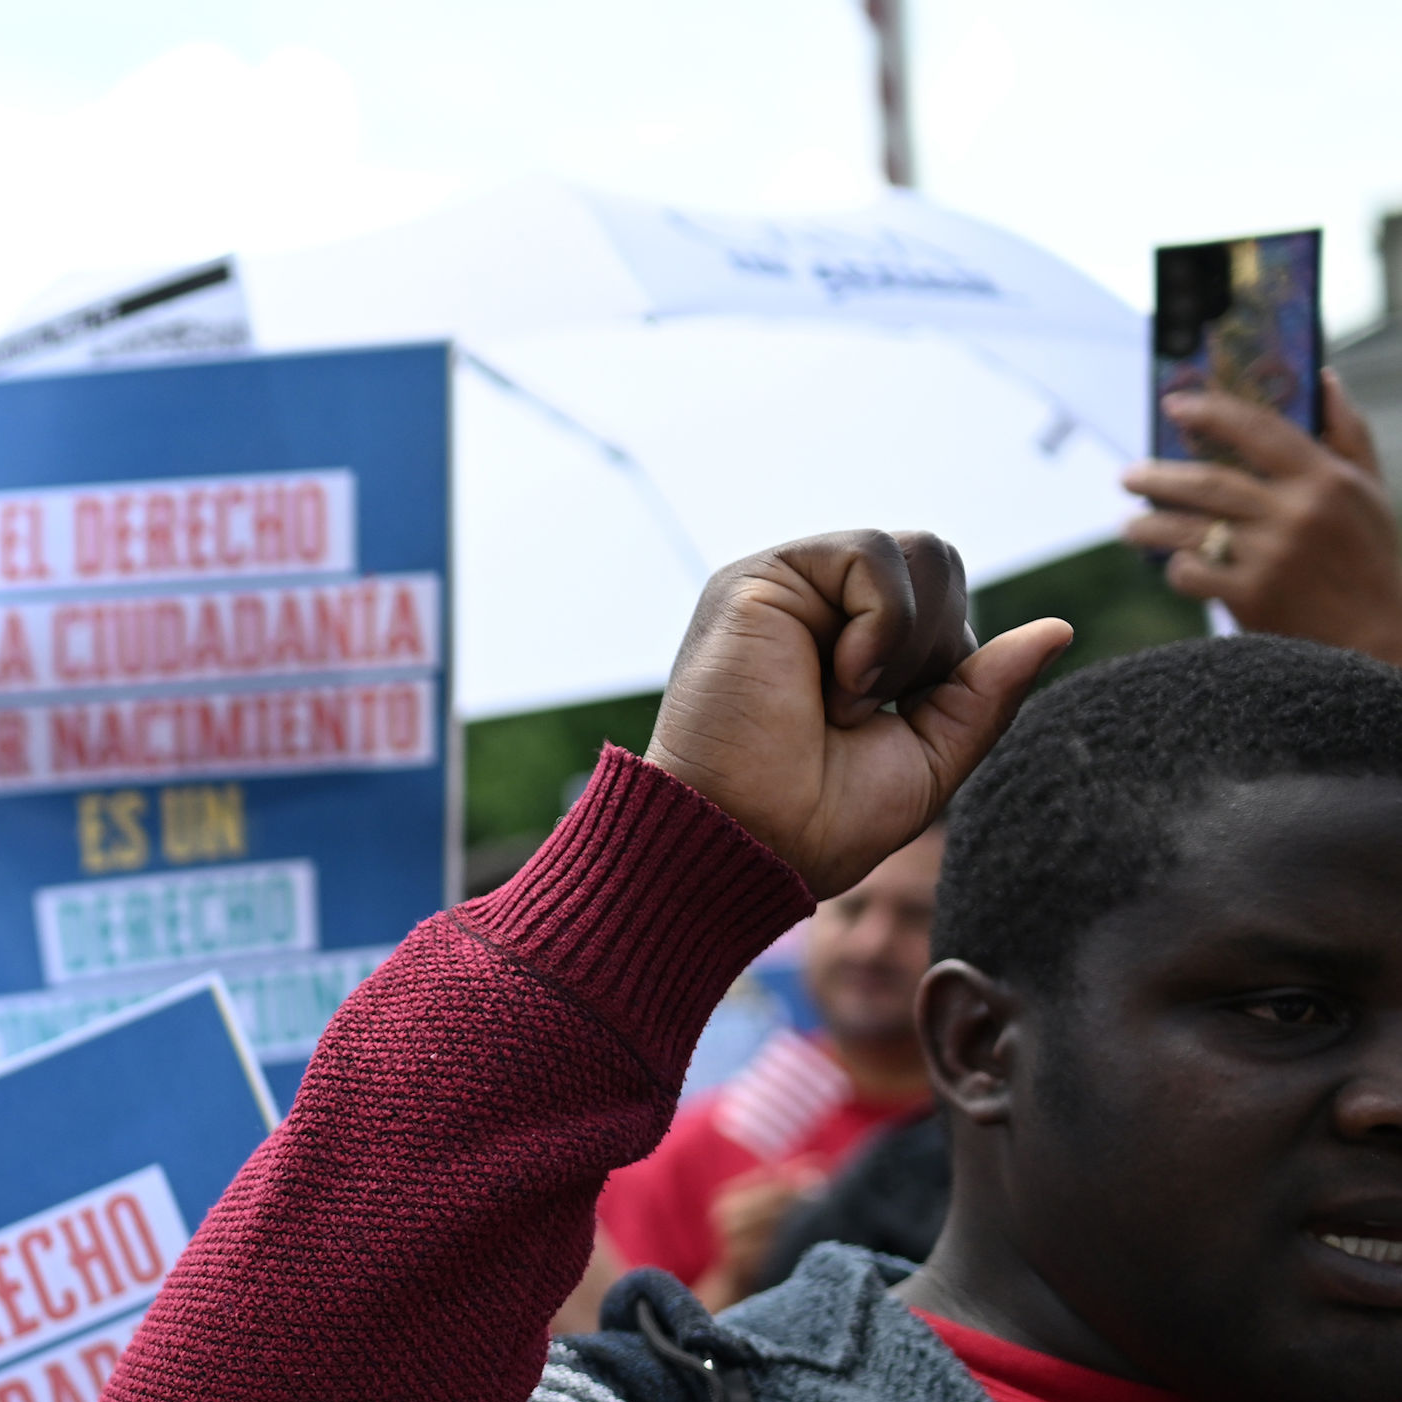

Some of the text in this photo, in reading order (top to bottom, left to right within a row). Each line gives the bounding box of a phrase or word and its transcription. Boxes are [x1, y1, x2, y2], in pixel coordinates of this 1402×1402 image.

[0, 481, 328, 582] EL DERECHO
[53, 575, 423, 682] CIUDADANÍA
[53, 684, 420, 772] NACIMIENTO
[78, 785, 248, 873] ES UN
[59, 875, 297, 972] DERECHO
